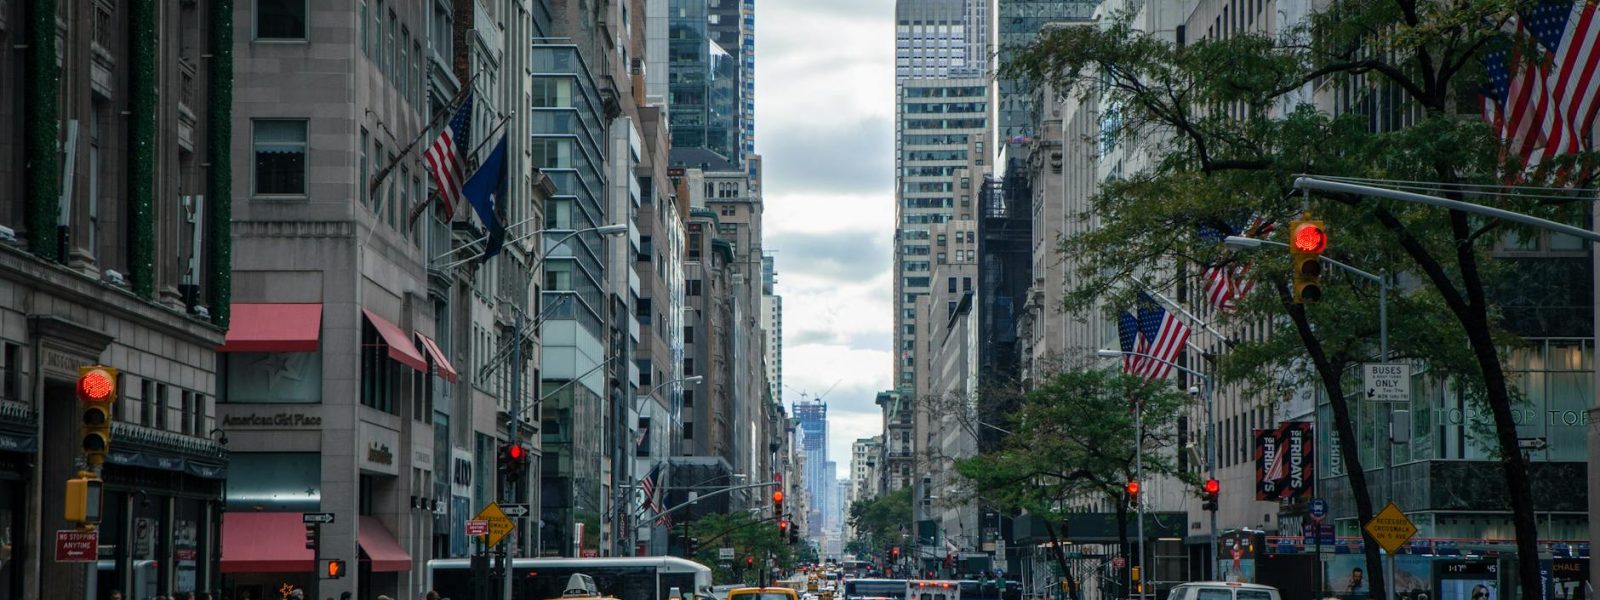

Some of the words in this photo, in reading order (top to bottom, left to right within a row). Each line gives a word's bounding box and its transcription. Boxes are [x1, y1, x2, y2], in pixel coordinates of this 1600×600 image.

[1372, 366, 1402, 375] BUSES
[223, 413, 273, 426] American
[274, 413, 293, 426] Girl
[294, 413, 322, 426] Place
[454, 457, 472, 486] ALDO
[1264, 444, 1275, 492] FRIDYS
[1290, 437, 1303, 489] FRIDAYS
